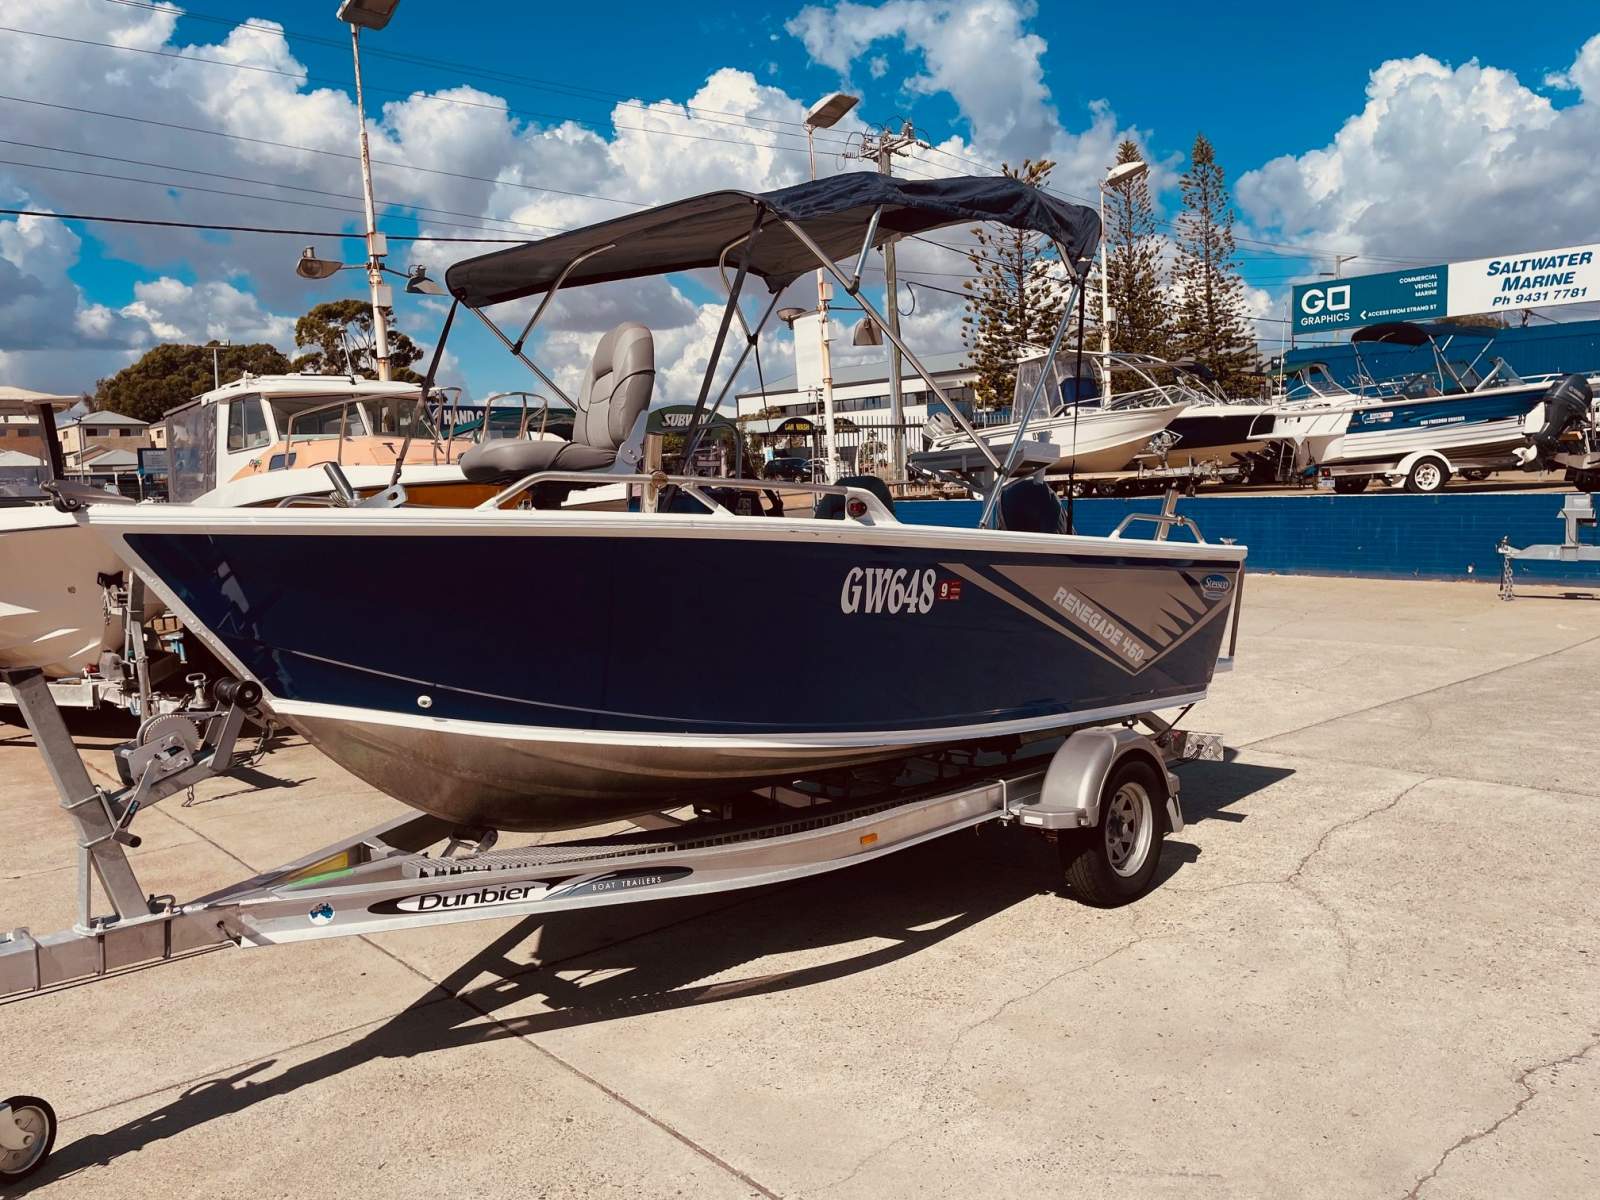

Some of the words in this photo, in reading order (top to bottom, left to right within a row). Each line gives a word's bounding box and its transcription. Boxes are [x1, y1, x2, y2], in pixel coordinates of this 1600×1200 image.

[1486, 251, 1594, 277] SALTWATER
[1399, 273, 1438, 284] COMMERCIAL
[1414, 281, 1438, 290] VEHICLE
[1501, 271, 1576, 292] MARINE
[1414, 289, 1438, 297] MARINE
[1492, 296, 1511, 306] Ph
[1515, 291, 1549, 304] 9431
[1553, 286, 1588, 300] 7781
[1301, 312, 1351, 326] GRAPHICS
[1367, 309, 1390, 317] ACCESS
[1390, 307, 1406, 315] FROM
[443, 409, 475, 425] HAND
[840, 566, 937, 615] GW648
[940, 582, 949, 597] 9
[1053, 586, 1124, 645] RENEGADE
[1122, 636, 1145, 662] 460
[592, 881, 616, 892] BOAT
[621, 876, 662, 888] TRAILERS
[418, 885, 536, 911] Dunbier
